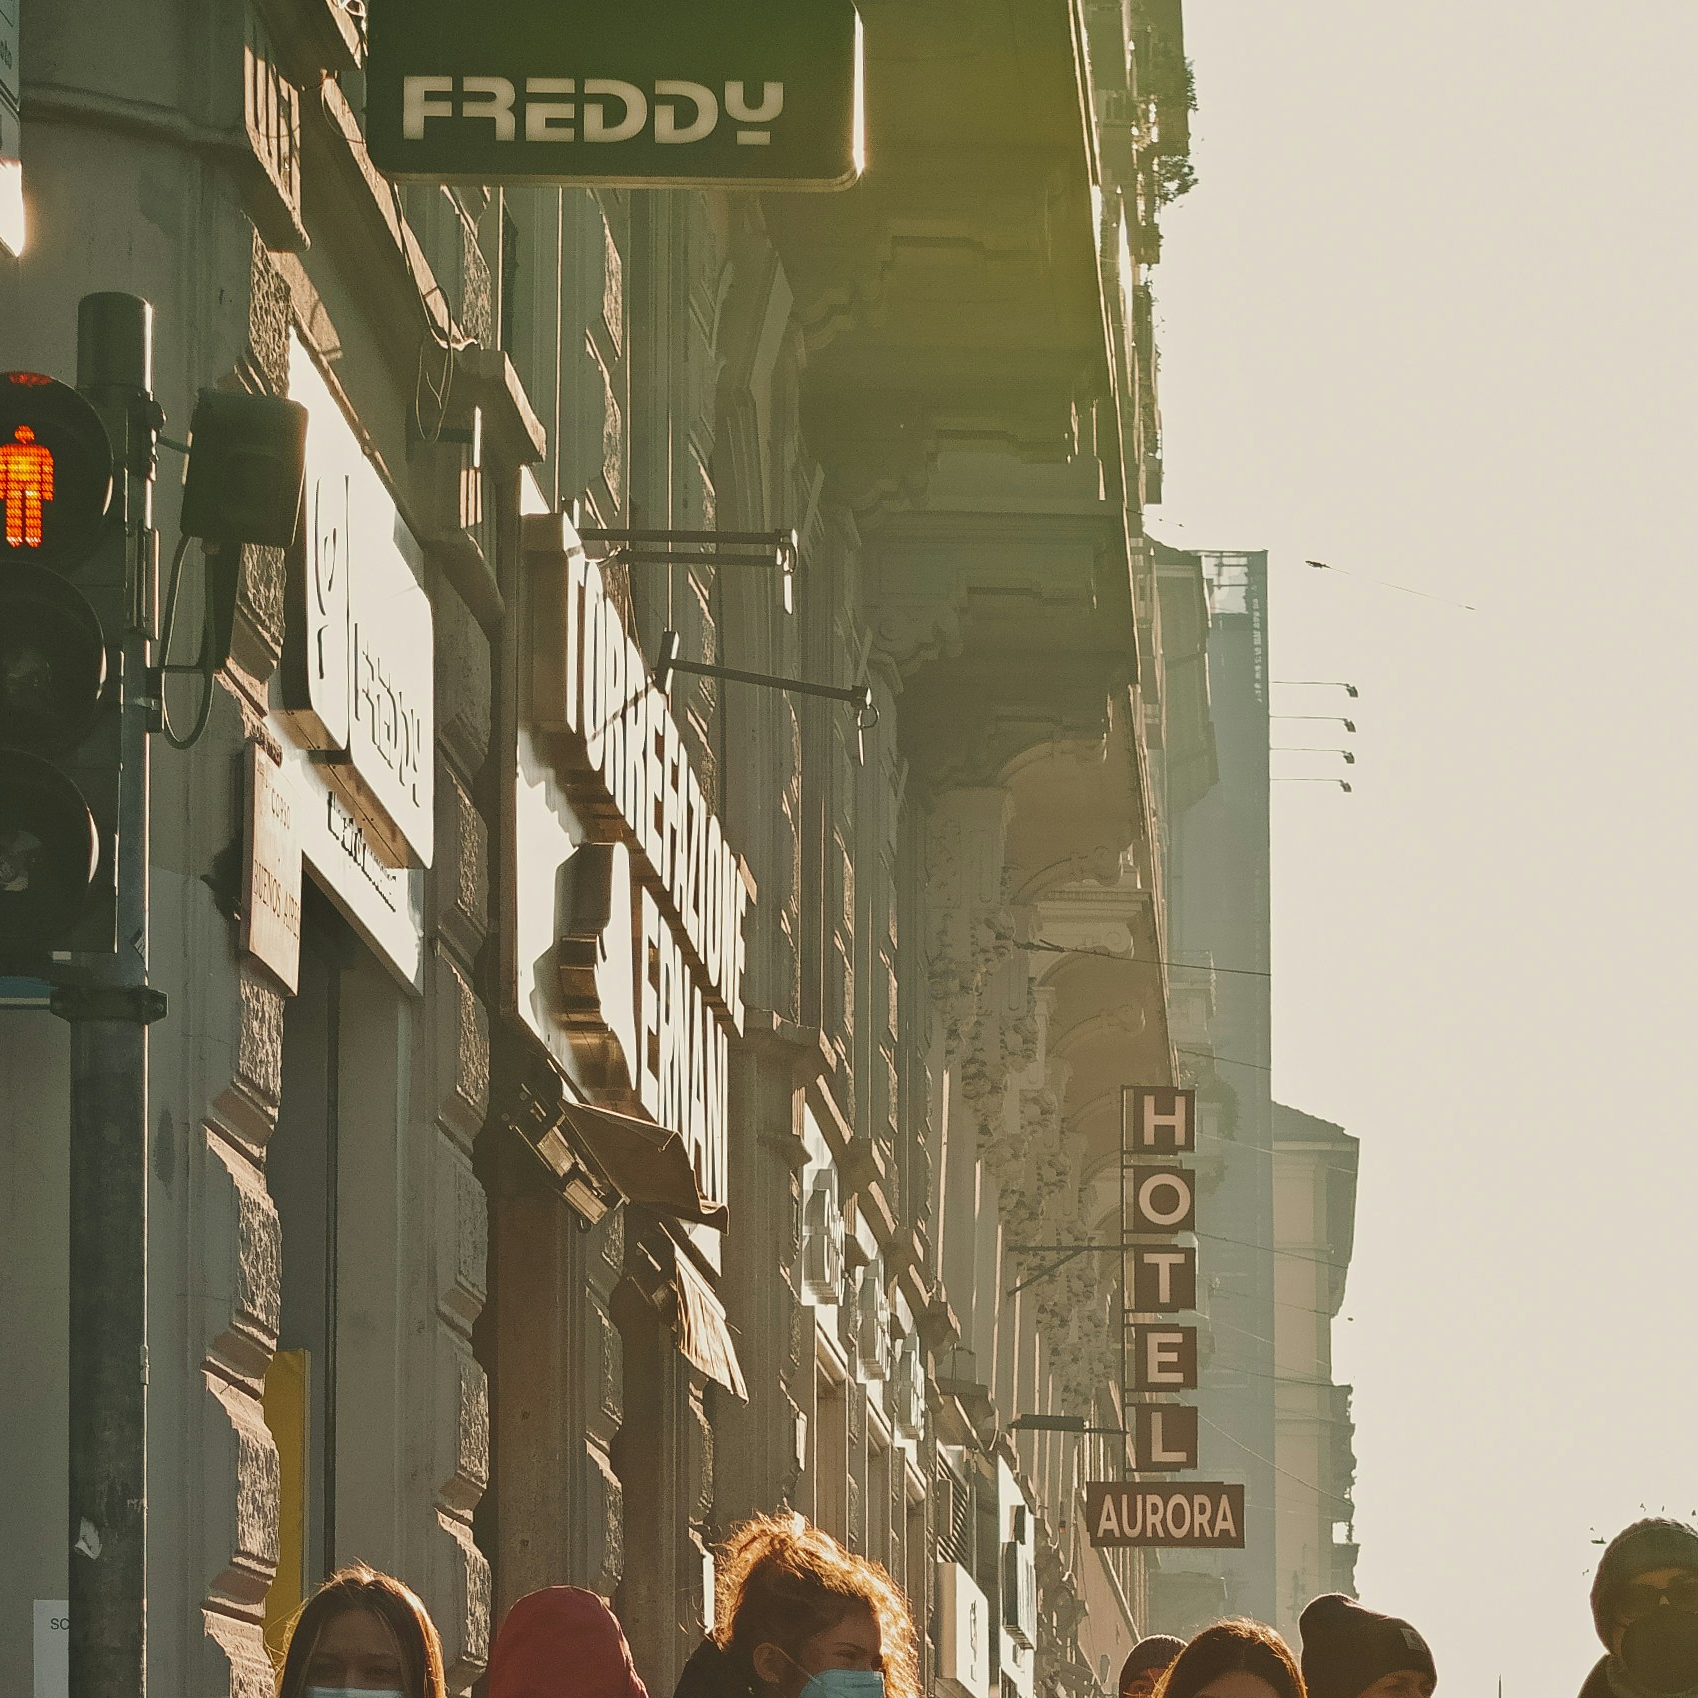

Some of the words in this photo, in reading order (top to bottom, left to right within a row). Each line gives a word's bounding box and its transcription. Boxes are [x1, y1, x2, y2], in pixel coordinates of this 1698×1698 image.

[401, 75, 785, 147] FREDDY
[562, 510, 746, 1039] TORREFAZIONE
[253, 859, 282, 920] BUENOS
[1138, 1094, 1191, 1463] HOTEL
[1096, 1492, 1237, 1539] AURORA
